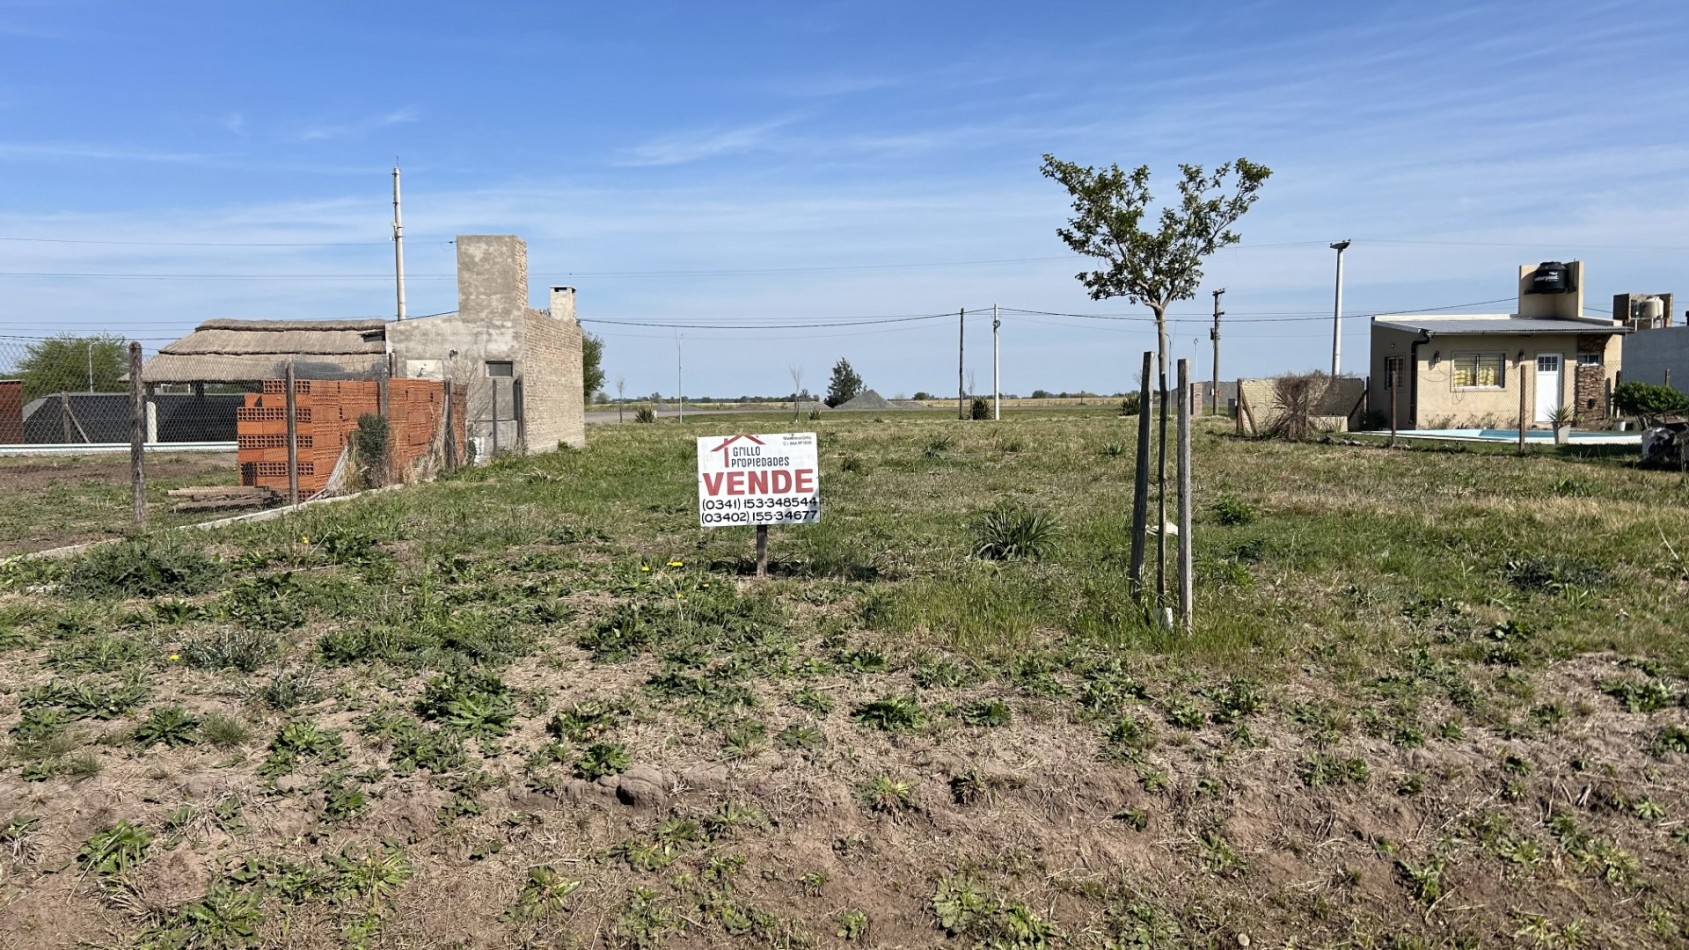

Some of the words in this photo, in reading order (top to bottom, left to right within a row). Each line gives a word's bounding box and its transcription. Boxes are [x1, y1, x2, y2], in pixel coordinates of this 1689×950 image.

[702, 469, 814, 496] VENDE
[702, 498, 741, 511] (0341)
[701, 511, 750, 524] (03402)
